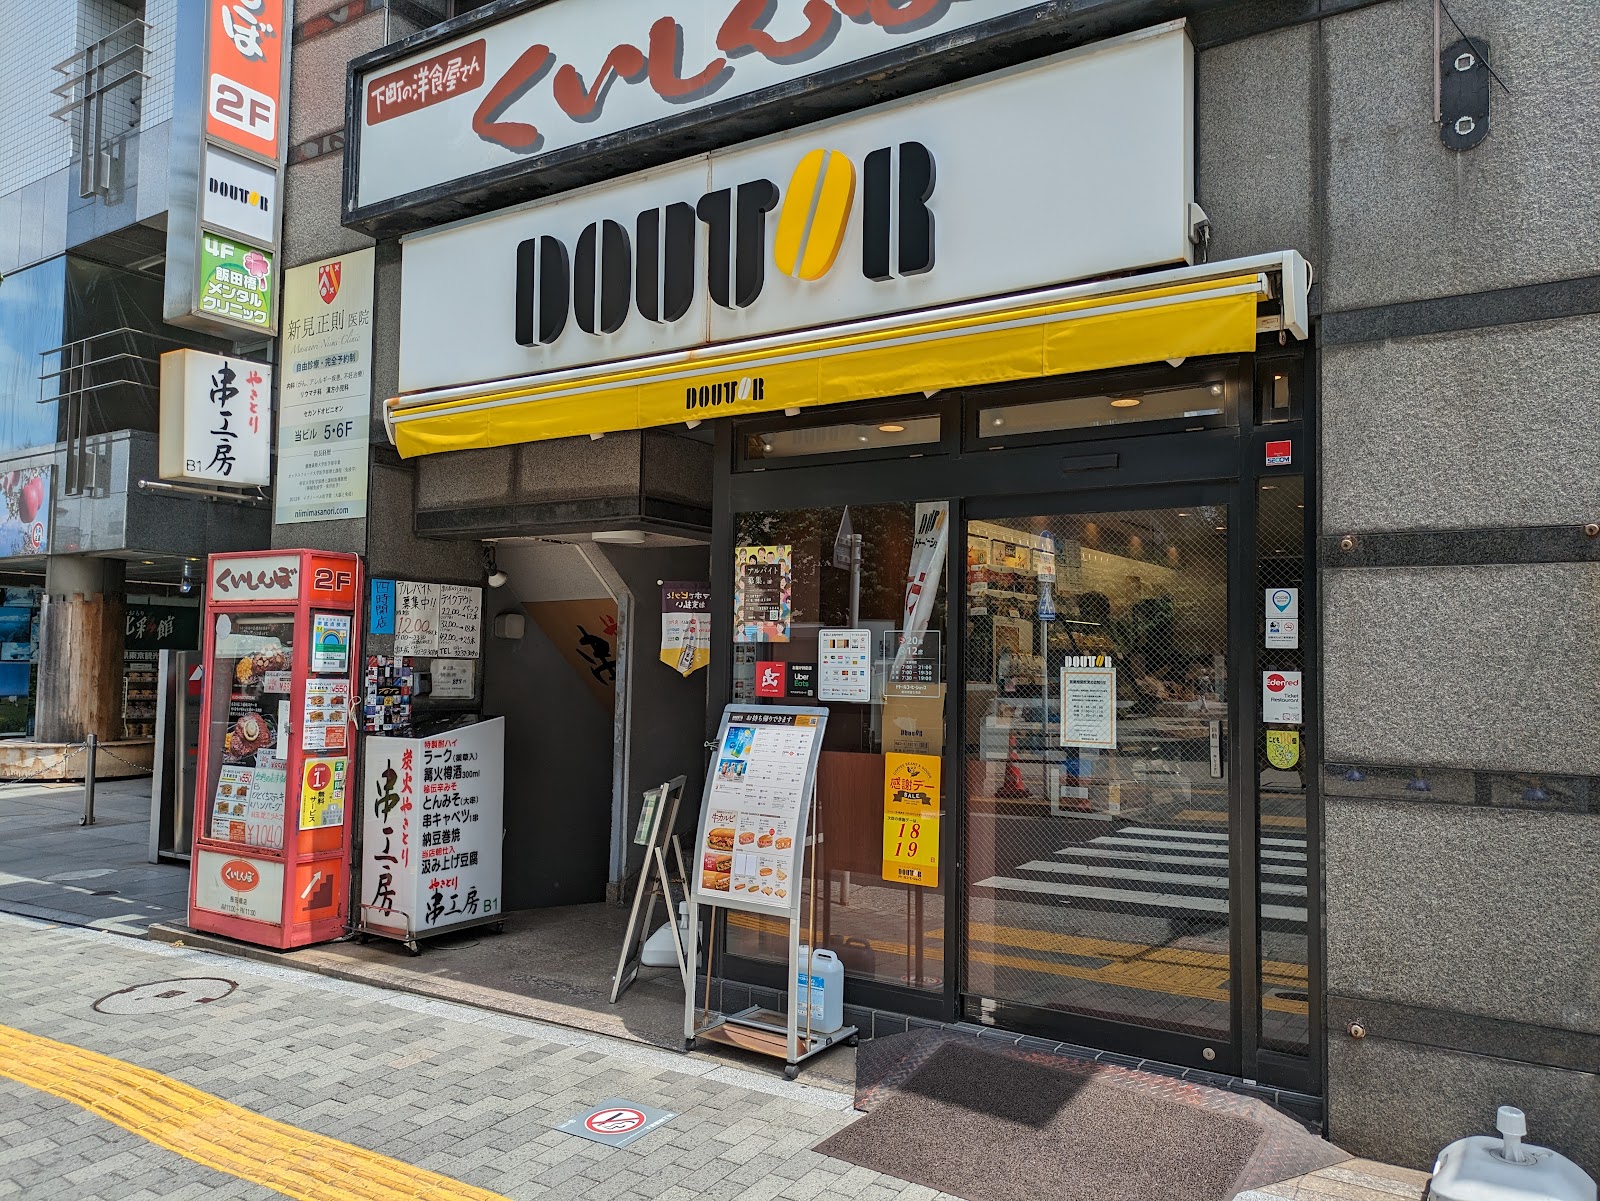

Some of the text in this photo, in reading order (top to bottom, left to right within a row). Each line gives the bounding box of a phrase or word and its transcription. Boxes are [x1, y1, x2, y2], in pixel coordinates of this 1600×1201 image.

[472, 0, 945, 148] くいしん
[371, 56, 481, 114] 下町の洋食屋さん
[215, 83, 271, 128] 2F
[209, 177, 268, 212] DOUTOR
[205, 237, 235, 260] 4F
[515, 141, 936, 347] DOUTOR
[216, 266, 257, 291] 飯田橋
[203, 281, 262, 307] メンタル
[203, 296, 266, 323] クリニック
[246, 370, 262, 434] やきとり
[686, 377, 764, 409] DOUTOR
[205, 361, 240, 476] 串工房
[303, 405, 344, 418] セカンドオピニオン
[294, 428, 318, 442] 当ビル
[186, 459, 202, 472] B1
[294, 506, 349, 518] niimimasanori.com
[216, 567, 297, 592] くいしんぼ
[314, 567, 352, 591] 2F
[748, 566, 779, 576] アルバイト
[398, 582, 432, 595] アルバイト
[441, 595, 472, 606] テイクアウト
[440, 647, 451, 655] TEL
[1064, 655, 1113, 668] DOUTOR
[794, 673, 810, 681] Uber
[424, 739, 458, 749] 特製酎ハイ
[423, 782, 457, 794] 秘伝辛みそ
[890, 777, 935, 791] 感謝デー
[309, 796, 317, 823] サービス
[400, 748, 413, 868] 炭火やきとり
[712, 812, 736, 824] 牛カルビ
[248, 825, 283, 847] ¥1040
[371, 758, 401, 917] 串工房
[422, 828, 460, 847] 納豆巻焼
[895, 842, 918, 858] 19
[422, 851, 478, 874] 汲み上げ豆腐
[225, 867, 255, 882] くいしんぼ
[898, 868, 922, 878] DOUTOR
[429, 876, 458, 891] やきとり
[425, 886, 480, 925] 串工房
[483, 898, 498, 912] B1
